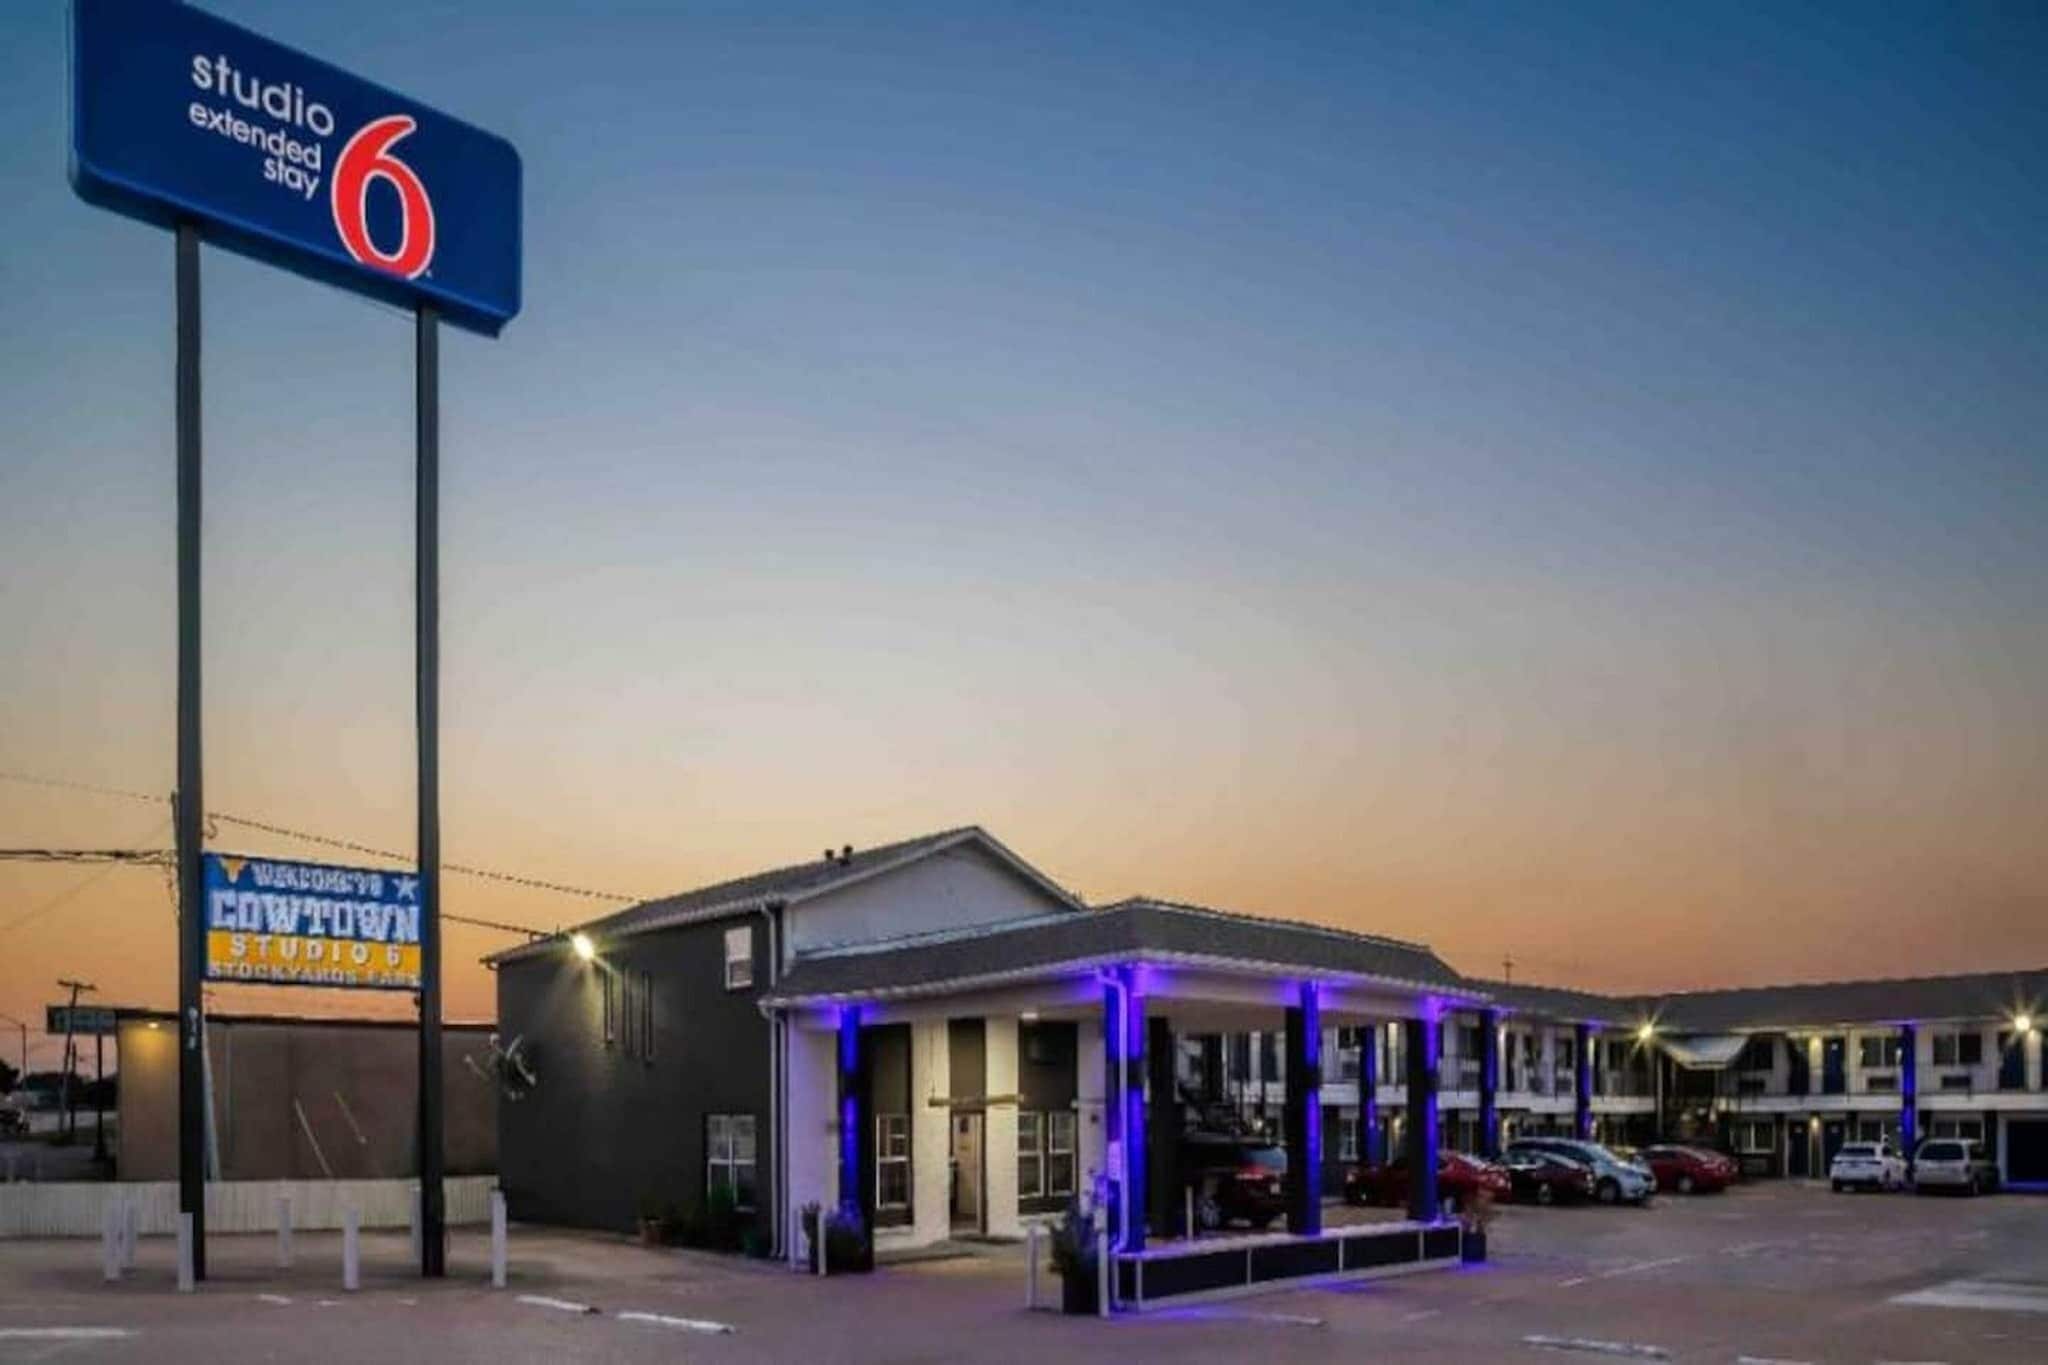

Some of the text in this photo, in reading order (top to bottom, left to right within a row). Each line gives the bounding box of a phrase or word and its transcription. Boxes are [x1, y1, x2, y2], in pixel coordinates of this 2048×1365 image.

[192, 54, 335, 136] studio
[189, 102, 322, 170] extended
[263, 157, 320, 200] stay
[331, 114, 435, 280] 6
[207, 889, 420, 943] COWTOWN
[230, 932, 402, 966] STUDIO 6
